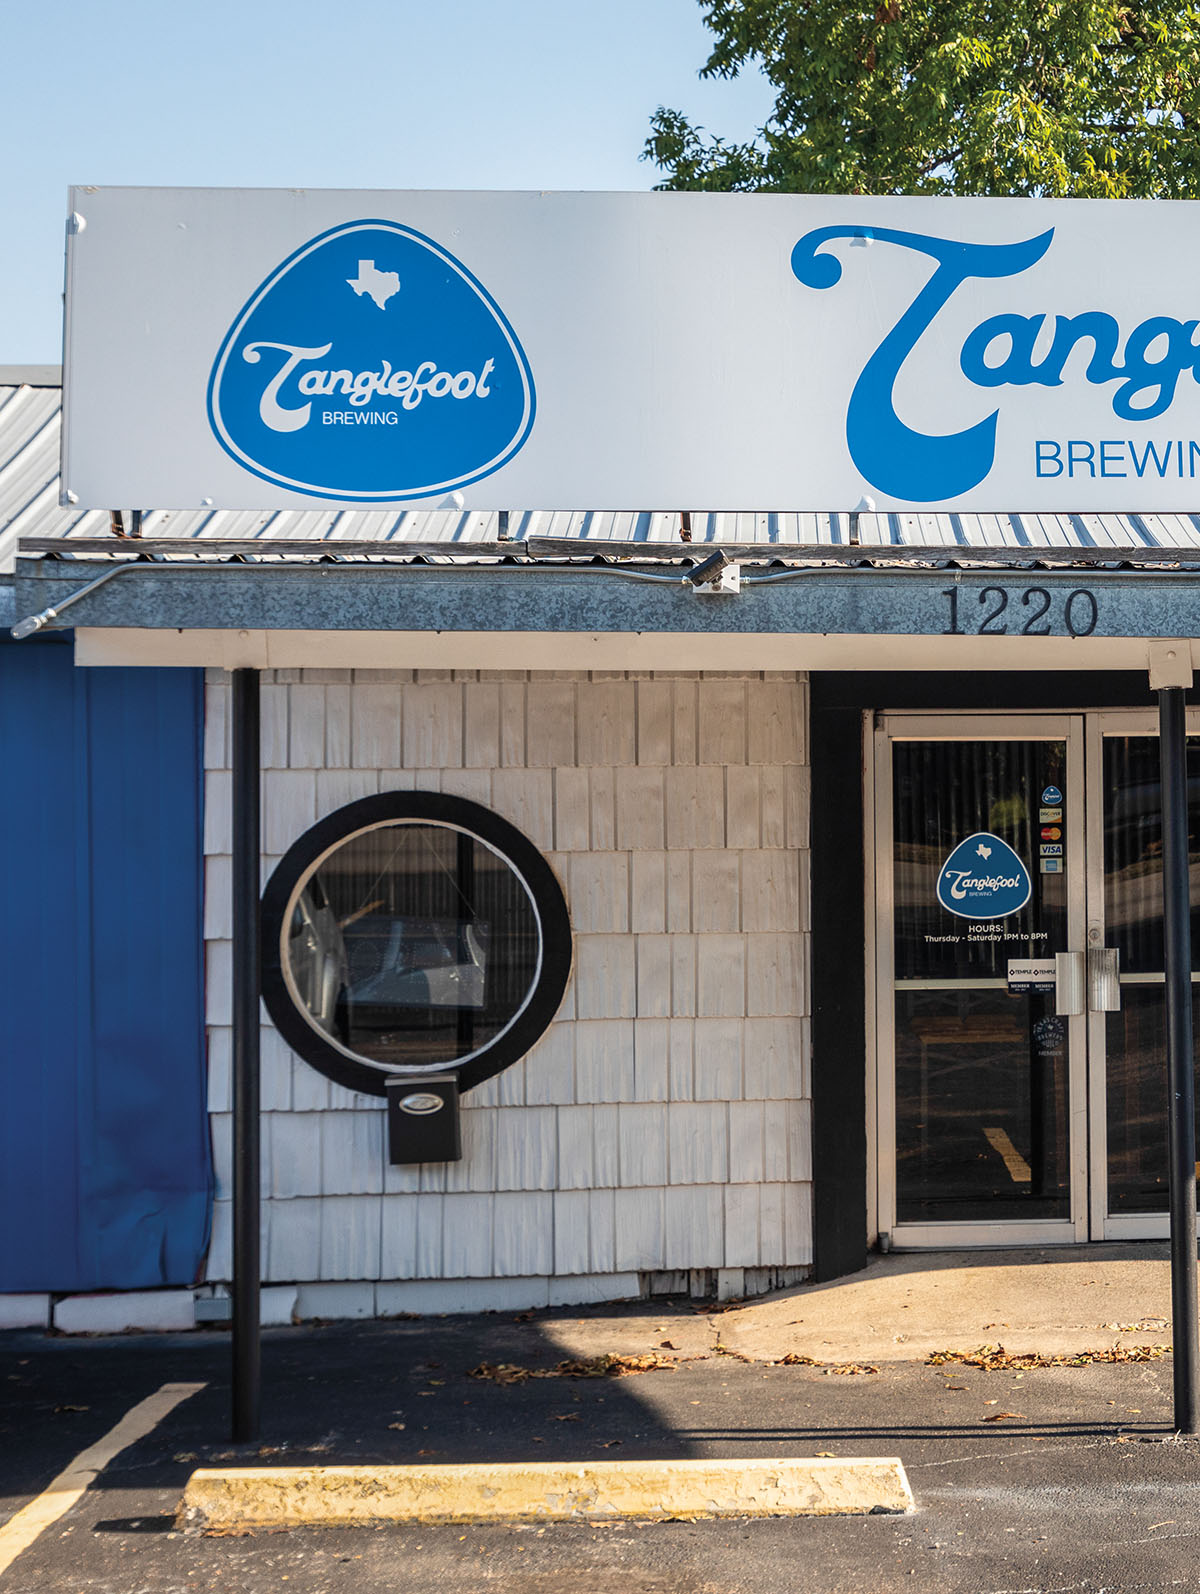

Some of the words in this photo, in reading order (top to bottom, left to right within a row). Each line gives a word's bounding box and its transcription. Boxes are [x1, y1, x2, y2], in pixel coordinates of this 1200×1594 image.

[242, 340, 497, 433] Tanglefoot
[321, 411, 399, 427] BREWING
[942, 585, 1098, 638] 1220
[1042, 846, 1062, 854] VISA
[945, 870, 1020, 900] Tanglefoot
[968, 925, 1004, 933] HOURS:
[924, 935, 961, 943] Thursday
[967, 934, 1002, 942] Saturday
